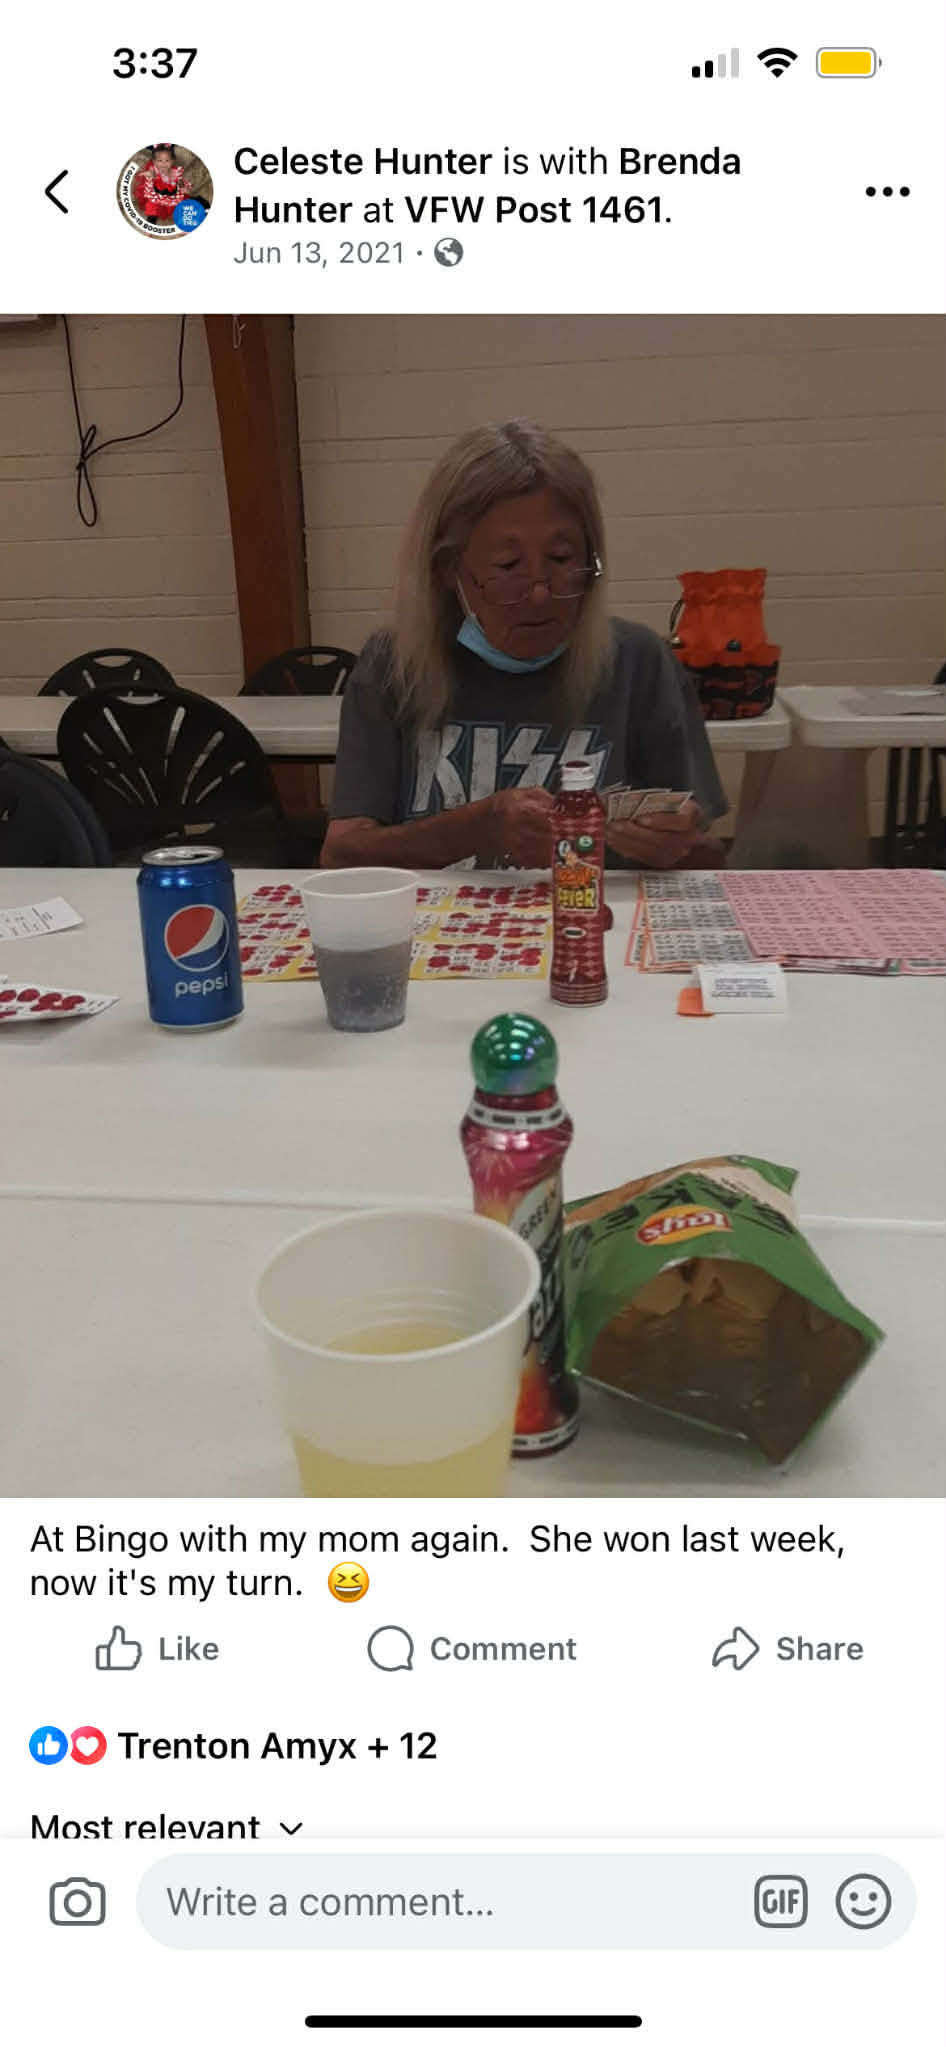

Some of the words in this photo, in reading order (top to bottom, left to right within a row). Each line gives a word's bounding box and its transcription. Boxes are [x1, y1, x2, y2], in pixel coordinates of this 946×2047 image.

[112, 47, 199, 80] 3:37
[234, 146, 364, 176] Celeste
[375, 146, 494, 176] Hunter
[503, 145, 529, 176] is
[539, 145, 608, 176] with
[619, 145, 741, 176] Brenda
[234, 195, 354, 224] Hunter
[363, 197, 395, 224] at
[403, 195, 485, 224] VFW
[496, 195, 573, 224] Post
[582, 195, 672, 225] 1461.
[233, 241, 281, 265] Jun
[291, 240, 328, 270] 13,
[339, 240, 403, 265] 2021
[408, 723, 610, 813] KISS
[174, 972, 229, 999] pepsi
[29, 1524, 65, 1553] At
[75, 1523, 169, 1560] Bingo
[179, 1523, 247, 1553] with
[259, 1530, 308, 1560] my
[318, 1530, 399, 1553] mom
[410, 1523, 509, 1560] again.
[529, 1523, 593, 1553] She
[602, 1528, 670, 1553] won
[682, 1523, 740, 1553] last
[749, 1523, 845, 1560] week,
[30, 1574, 98, 1597] now
[108, 1567, 157, 1597] it's
[168, 1574, 216, 1604] my
[225, 1569, 303, 1597] turn.
[159, 1634, 220, 1662] Like
[430, 1635, 577, 1662] Comment
[776, 1634, 865, 1662] Share
[117, 1731, 250, 1761] Trenton
[259, 1731, 358, 1767] Amyx
[367, 1736, 389, 1760] +
[399, 1731, 438, 1760] 12
[31, 1814, 114, 1839] Most
[124, 1812, 262, 1839] relevant
[166, 1884, 257, 1918] Write
[268, 1893, 288, 1917] a
[299, 1888, 494, 1917] comment...
[761, 1888, 801, 1915] GIF
